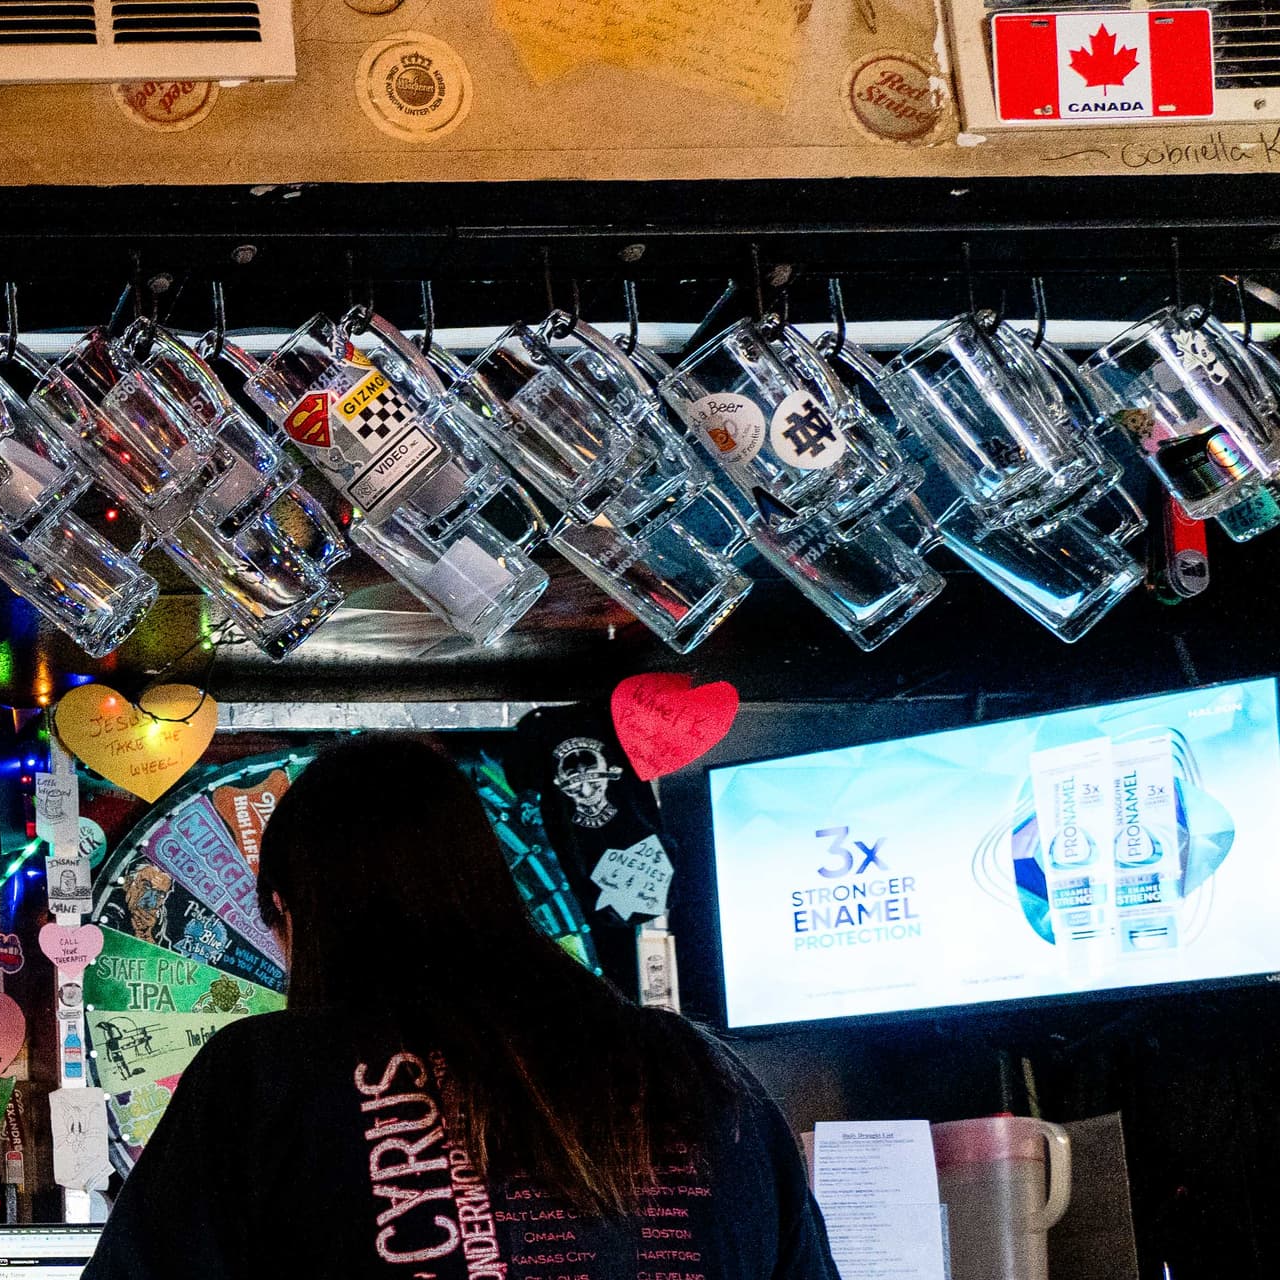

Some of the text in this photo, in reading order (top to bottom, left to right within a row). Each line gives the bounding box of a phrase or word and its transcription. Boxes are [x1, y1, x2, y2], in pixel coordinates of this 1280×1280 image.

[1068, 101, 1144, 113] CANADA
[1121, 132, 1249, 168] Gabriella
[707, 400, 744, 416] Beer
[376, 444, 408, 475] VIDEO
[106, 741, 144, 755] TAKE
[1148, 784, 1164, 797] 3x
[1062, 775, 1078, 858] PRONAMEL
[1124, 769, 1141, 857] PRONAMEL
[234, 795, 258, 865] HIGH LIFE
[608, 851, 667, 882] ONESIES
[815, 826, 889, 880] 3x
[162, 840, 225, 903] CHOICE
[791, 876, 916, 907] STRONGER
[793, 897, 919, 934] ENAMEL
[59, 938, 78, 946] CALL
[793, 922, 922, 952] PROTECTION
[54, 955, 87, 963] THERAPIST
[97, 957, 200, 985] STAFF PICK
[235, 948, 284, 978] WHAT KIND
[128, 982, 177, 1012] IPA
[185, 1029, 201, 1047] The
[354, 1051, 460, 1263] CYRUS
[677, 1186, 712, 1197] PARK
[495, 1209, 563, 1222] SALT LAKE
[638, 1208, 689, 1218] NEWARK
[524, 1231, 576, 1242] OMAHA
[642, 1229, 691, 1239] BOSTON
[511, 1251, 596, 1265] KANSAS CITY
[636, 1250, 701, 1262] HARTFORD
